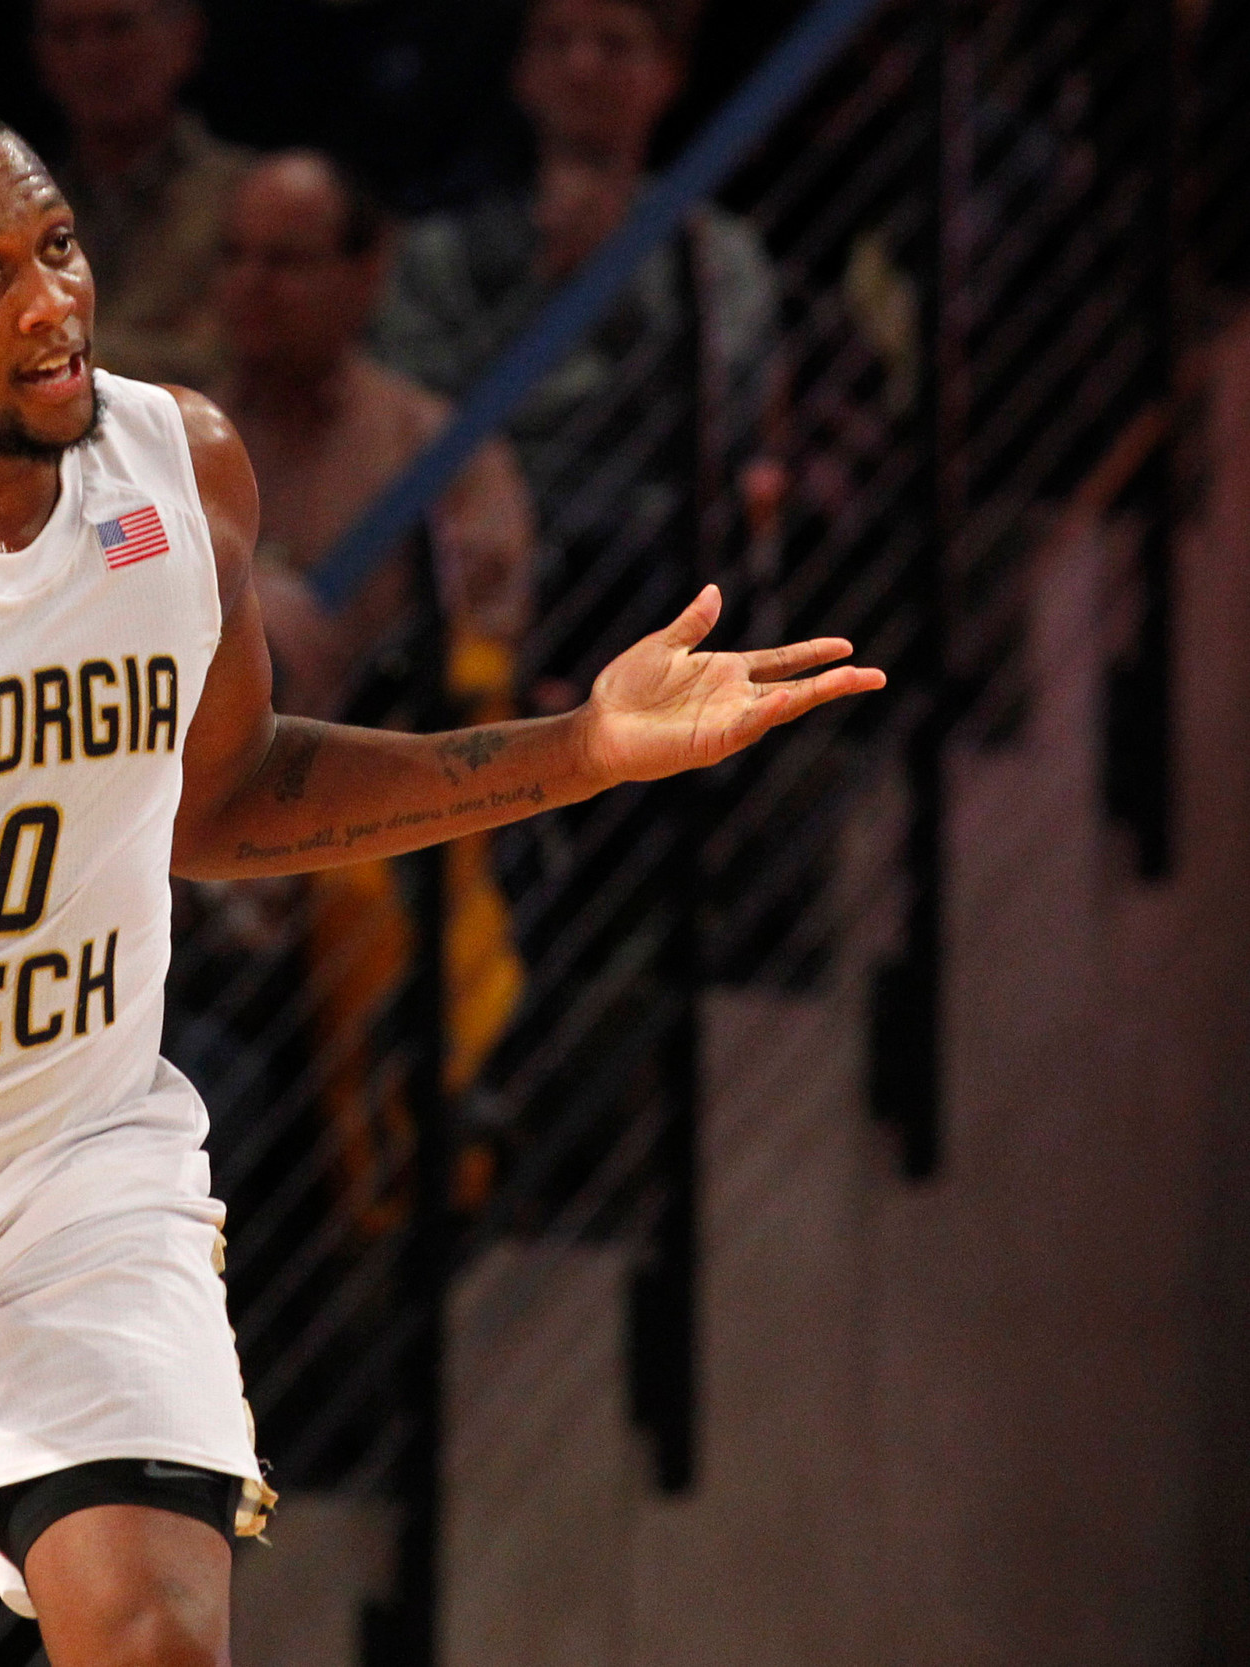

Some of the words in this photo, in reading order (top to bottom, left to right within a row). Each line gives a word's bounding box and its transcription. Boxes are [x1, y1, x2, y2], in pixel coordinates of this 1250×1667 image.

[344, 821, 382, 848] your
[386, 811, 443, 830] dreams
[449, 797, 486, 816] come
